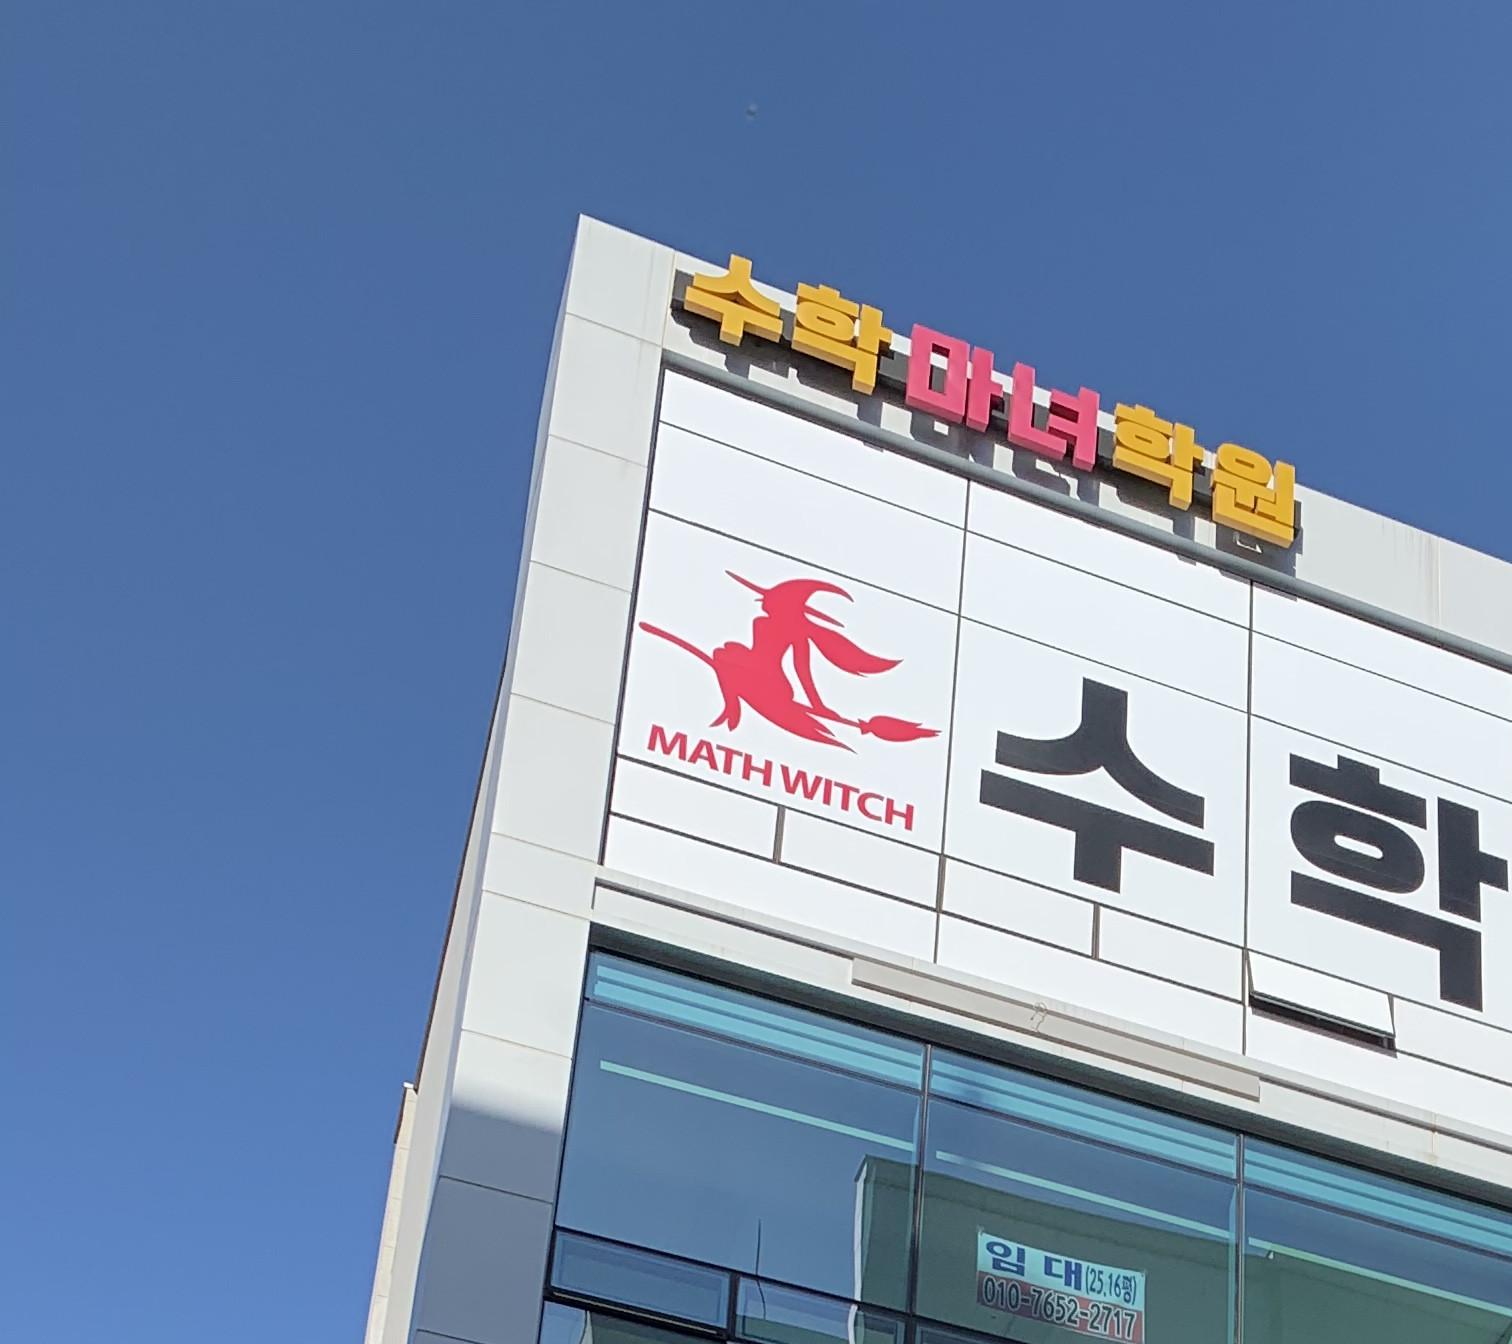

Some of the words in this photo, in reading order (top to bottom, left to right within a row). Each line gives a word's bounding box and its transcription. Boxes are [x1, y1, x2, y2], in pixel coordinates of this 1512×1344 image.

[647, 723, 773, 783] MATH
[780, 768, 915, 831] WITCH
[983, 1275, 1137, 1340] 010-7652-2717
